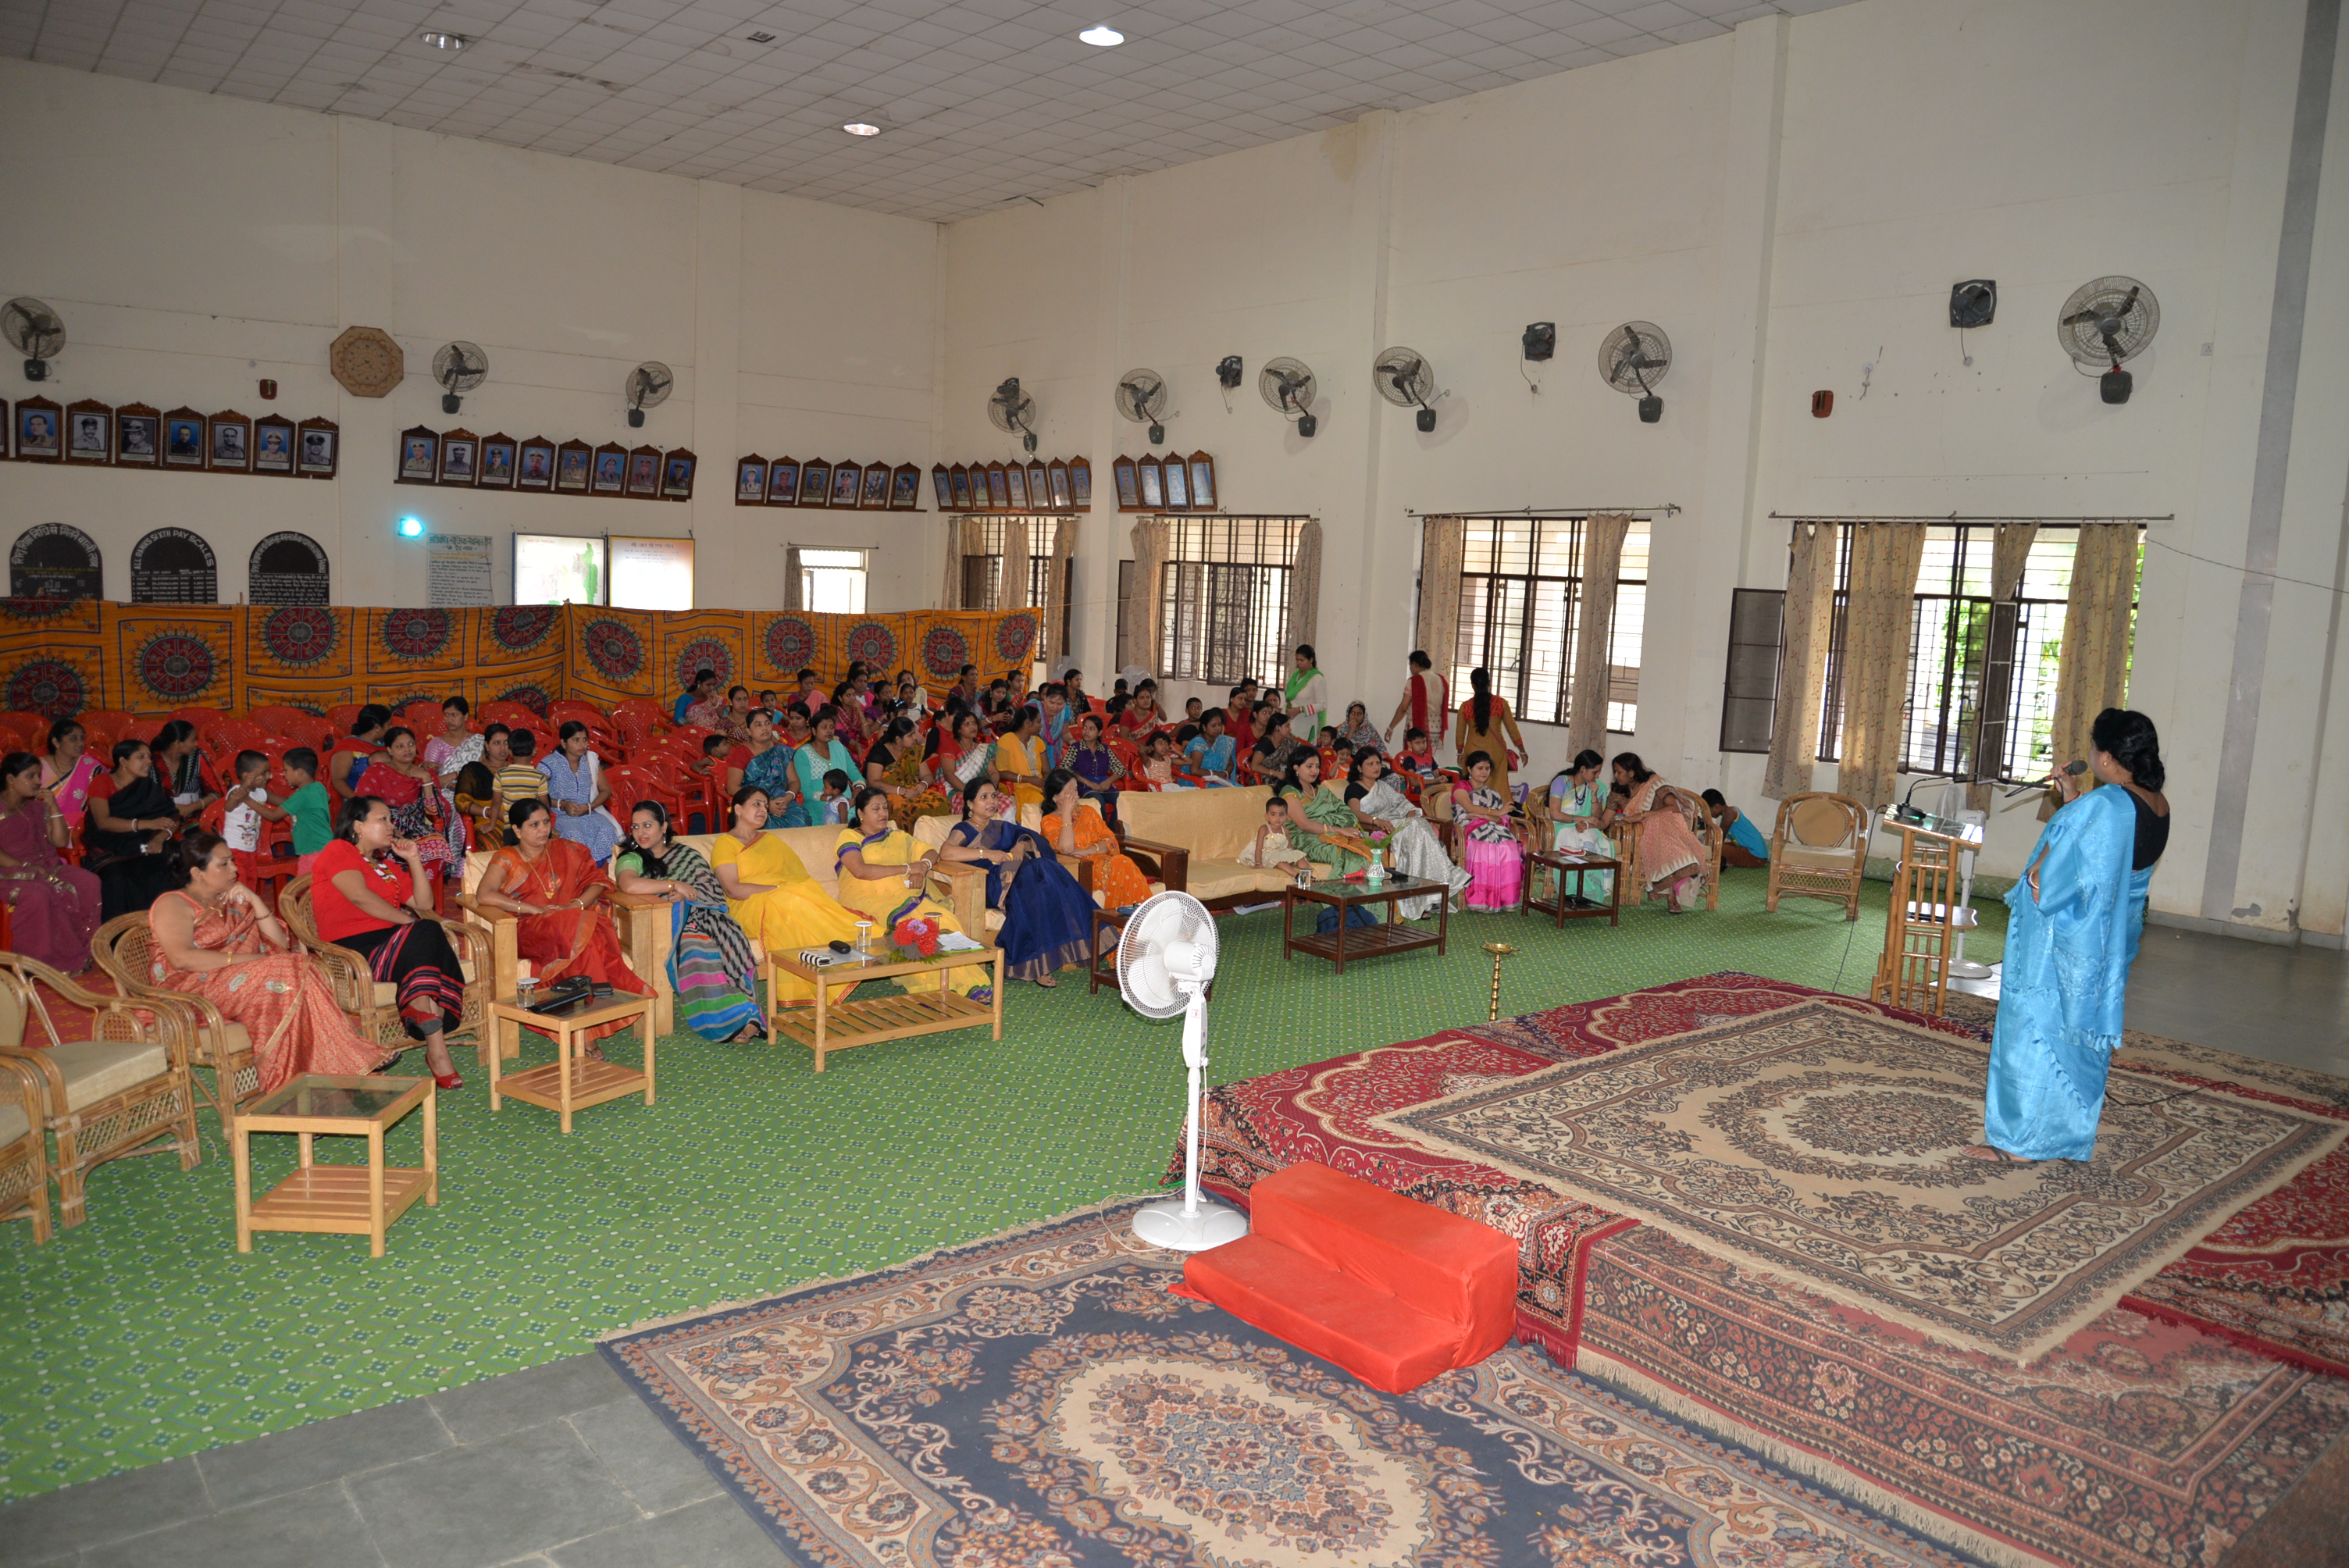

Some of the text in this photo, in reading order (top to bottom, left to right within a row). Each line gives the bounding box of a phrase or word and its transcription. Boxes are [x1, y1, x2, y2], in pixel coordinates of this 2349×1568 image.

[77, 535, 97, 553] वाली
[135, 537, 153, 558] RANKS
[150, 530, 171, 542] SIXTH
[173, 530, 189, 539] PAY
[188, 535, 214, 567] SCALES
